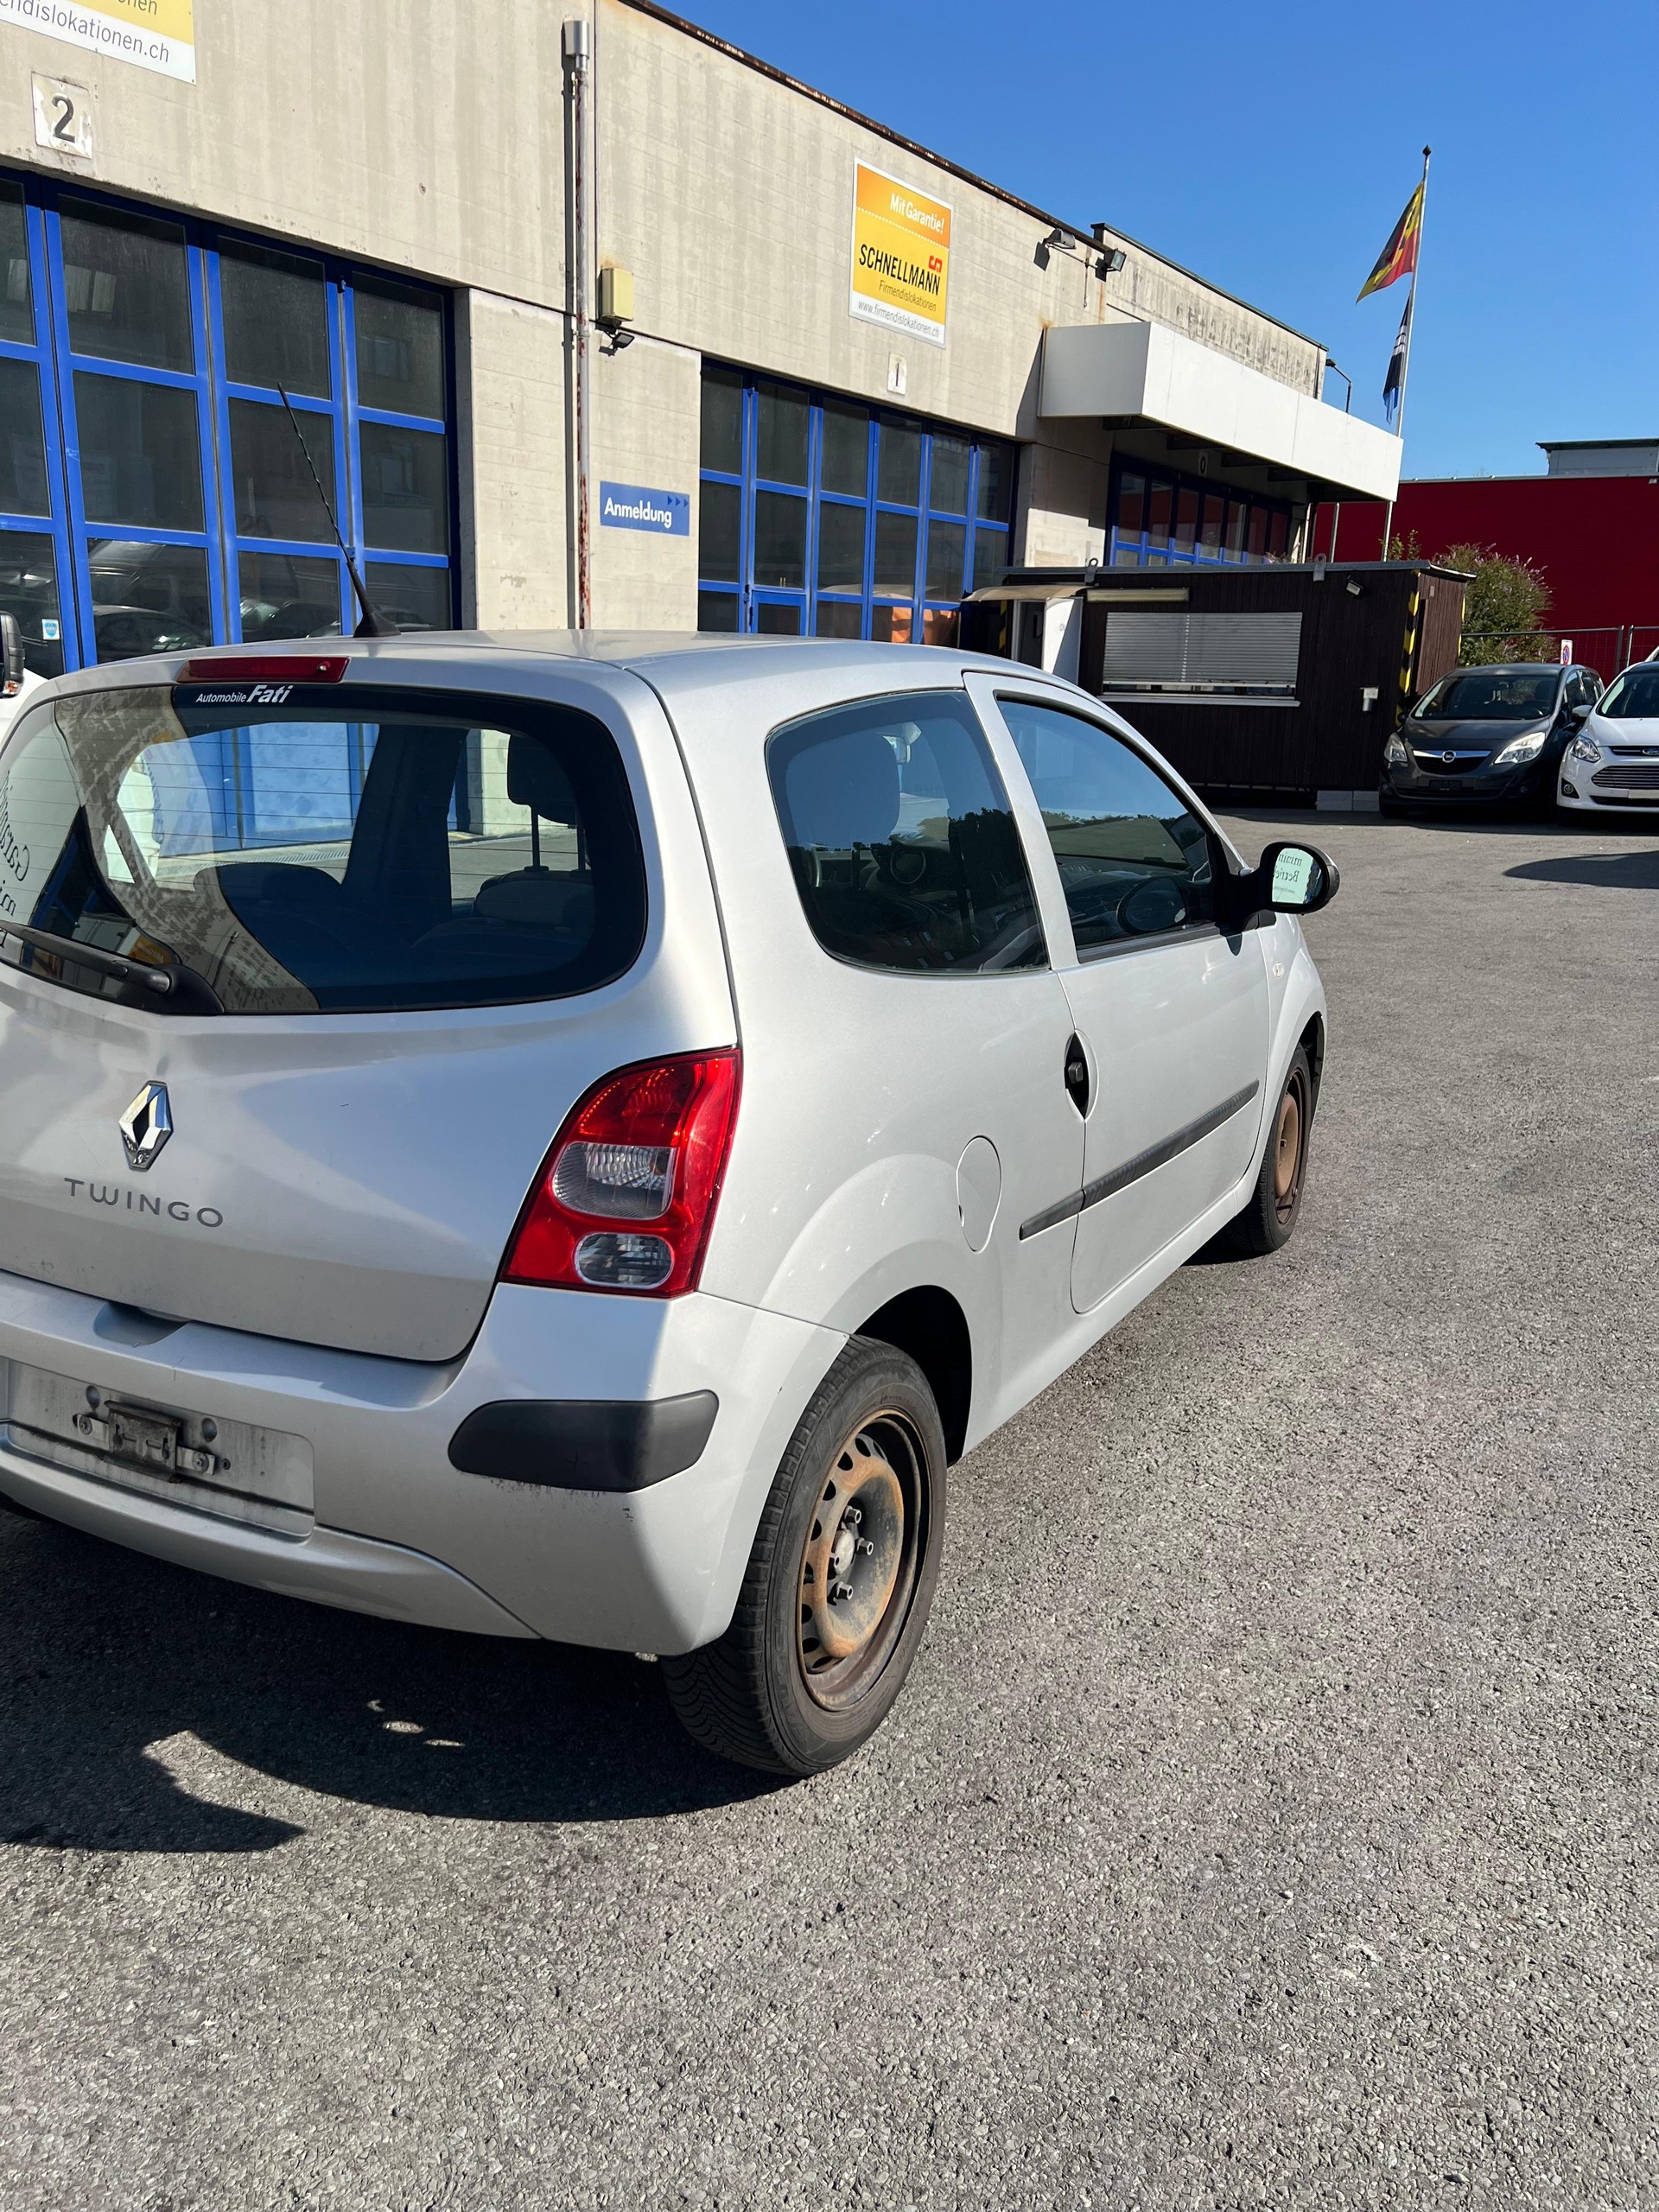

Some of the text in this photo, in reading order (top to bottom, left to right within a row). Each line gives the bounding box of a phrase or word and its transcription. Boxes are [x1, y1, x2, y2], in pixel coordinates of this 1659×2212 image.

[52, 94, 76, 143] 2
[890, 193, 945, 234] Mit Garantie!
[859, 244, 941, 296] SCHNELLMANN
[879, 280, 937, 312] Firmendislokationen
[858, 300, 939, 338] www.firmendislokationen.ch
[604, 497, 672, 529] Anmeldung
[195, 684, 294, 703] Automobile Fati
[64, 1177, 224, 1228] TWINGO
